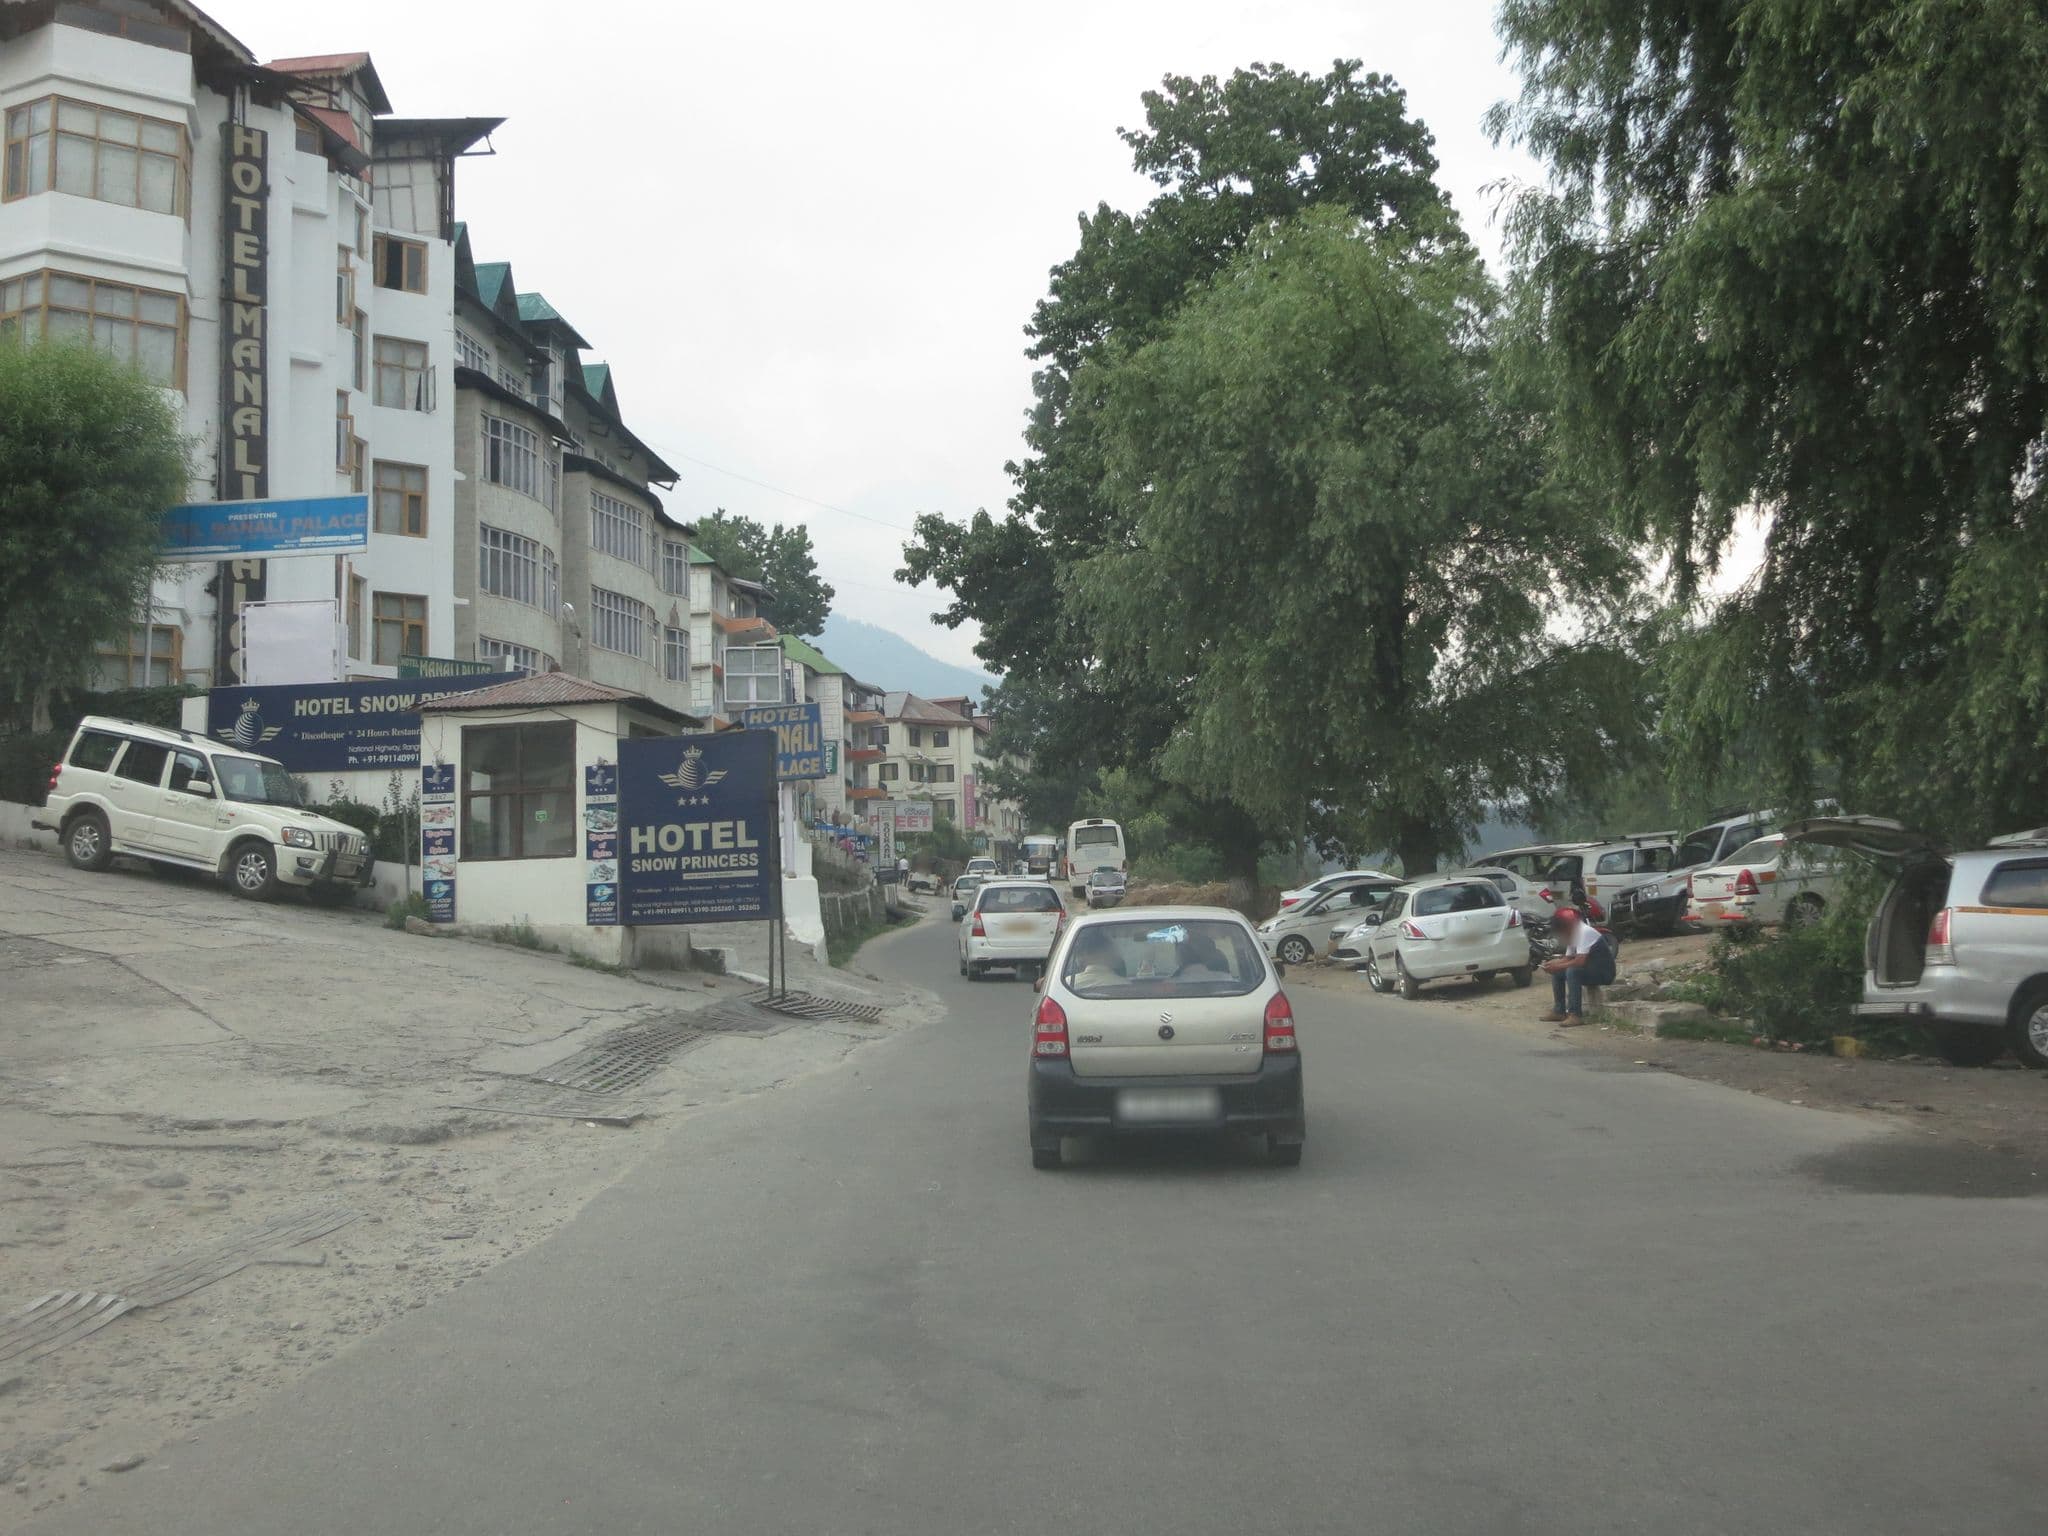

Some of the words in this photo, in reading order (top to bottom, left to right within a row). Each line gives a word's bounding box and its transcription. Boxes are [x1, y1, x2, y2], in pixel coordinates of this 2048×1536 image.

[232, 126, 262, 304] HOTEL
[232, 302, 262, 500] MANALI
[228, 511, 278, 521] PRESENTING
[291, 512, 367, 531] PALACE
[294, 697, 354, 716] HOTEL
[359, 694, 416, 713] SNOW
[750, 706, 811, 724] HOTEL
[356, 729, 366, 738] 24
[367, 728, 390, 738] Hours
[776, 722, 818, 755] NALI
[348, 756, 359, 764] Ph.
[778, 757, 820, 776] LACE
[870, 815, 930, 828] PEET
[630, 820, 758, 854] HOTEL
[631, 857, 677, 873] SNOW
[681, 853, 759, 870] PRINCESS
